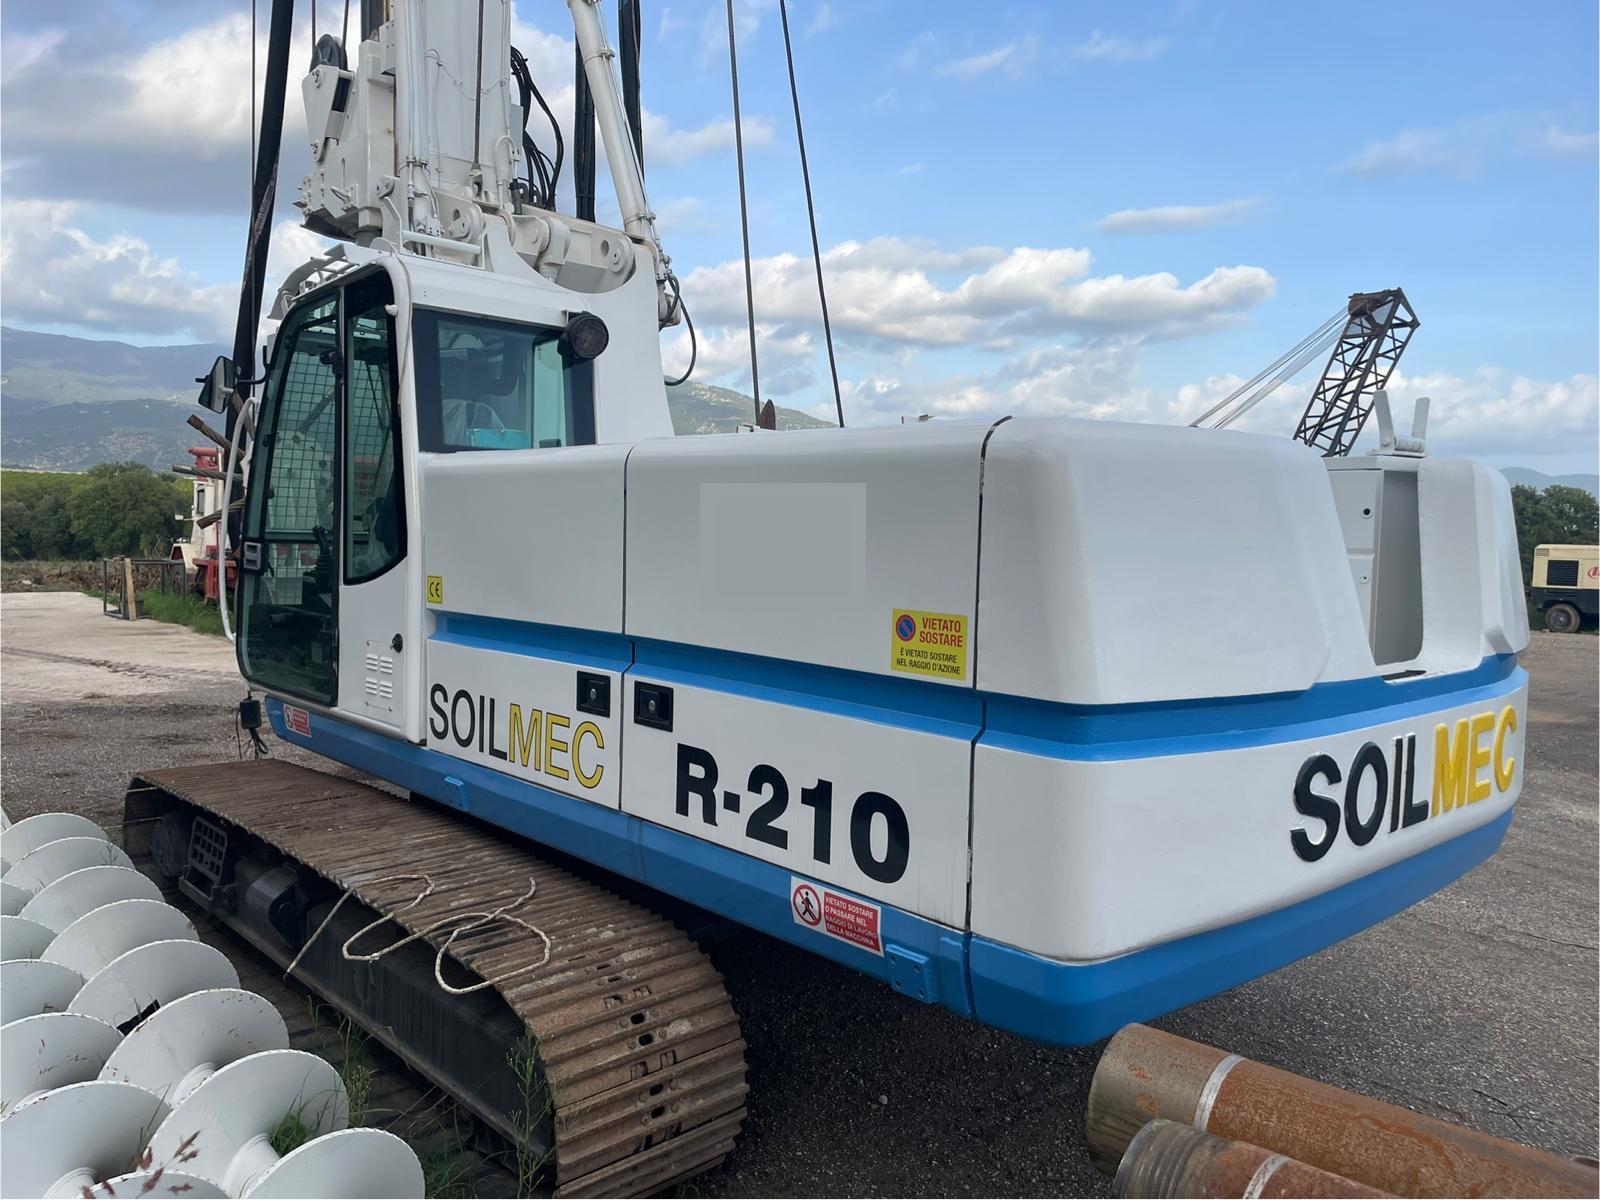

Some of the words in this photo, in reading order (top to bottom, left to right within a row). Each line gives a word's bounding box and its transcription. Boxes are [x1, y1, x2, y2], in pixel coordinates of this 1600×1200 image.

[922, 617, 961, 633] VIETATO
[919, 631, 963, 648] SOSTARE
[905, 648, 928, 660] VIETATO
[929, 651, 957, 663] SOSTARE
[896, 658, 907, 668] NEL
[908, 659, 931, 671] RAGGIO
[932, 662, 960, 675] D'AZIONE
[430, 683, 604, 789] SOILMEC
[1290, 704, 1517, 862] SOILMEC
[676, 743, 909, 884] R-210
[825, 896, 847, 909] VIETATO
[847, 903, 874, 919] SOSTARE
[830, 907, 855, 922] PASSARE
[856, 917, 867, 927] NEL
